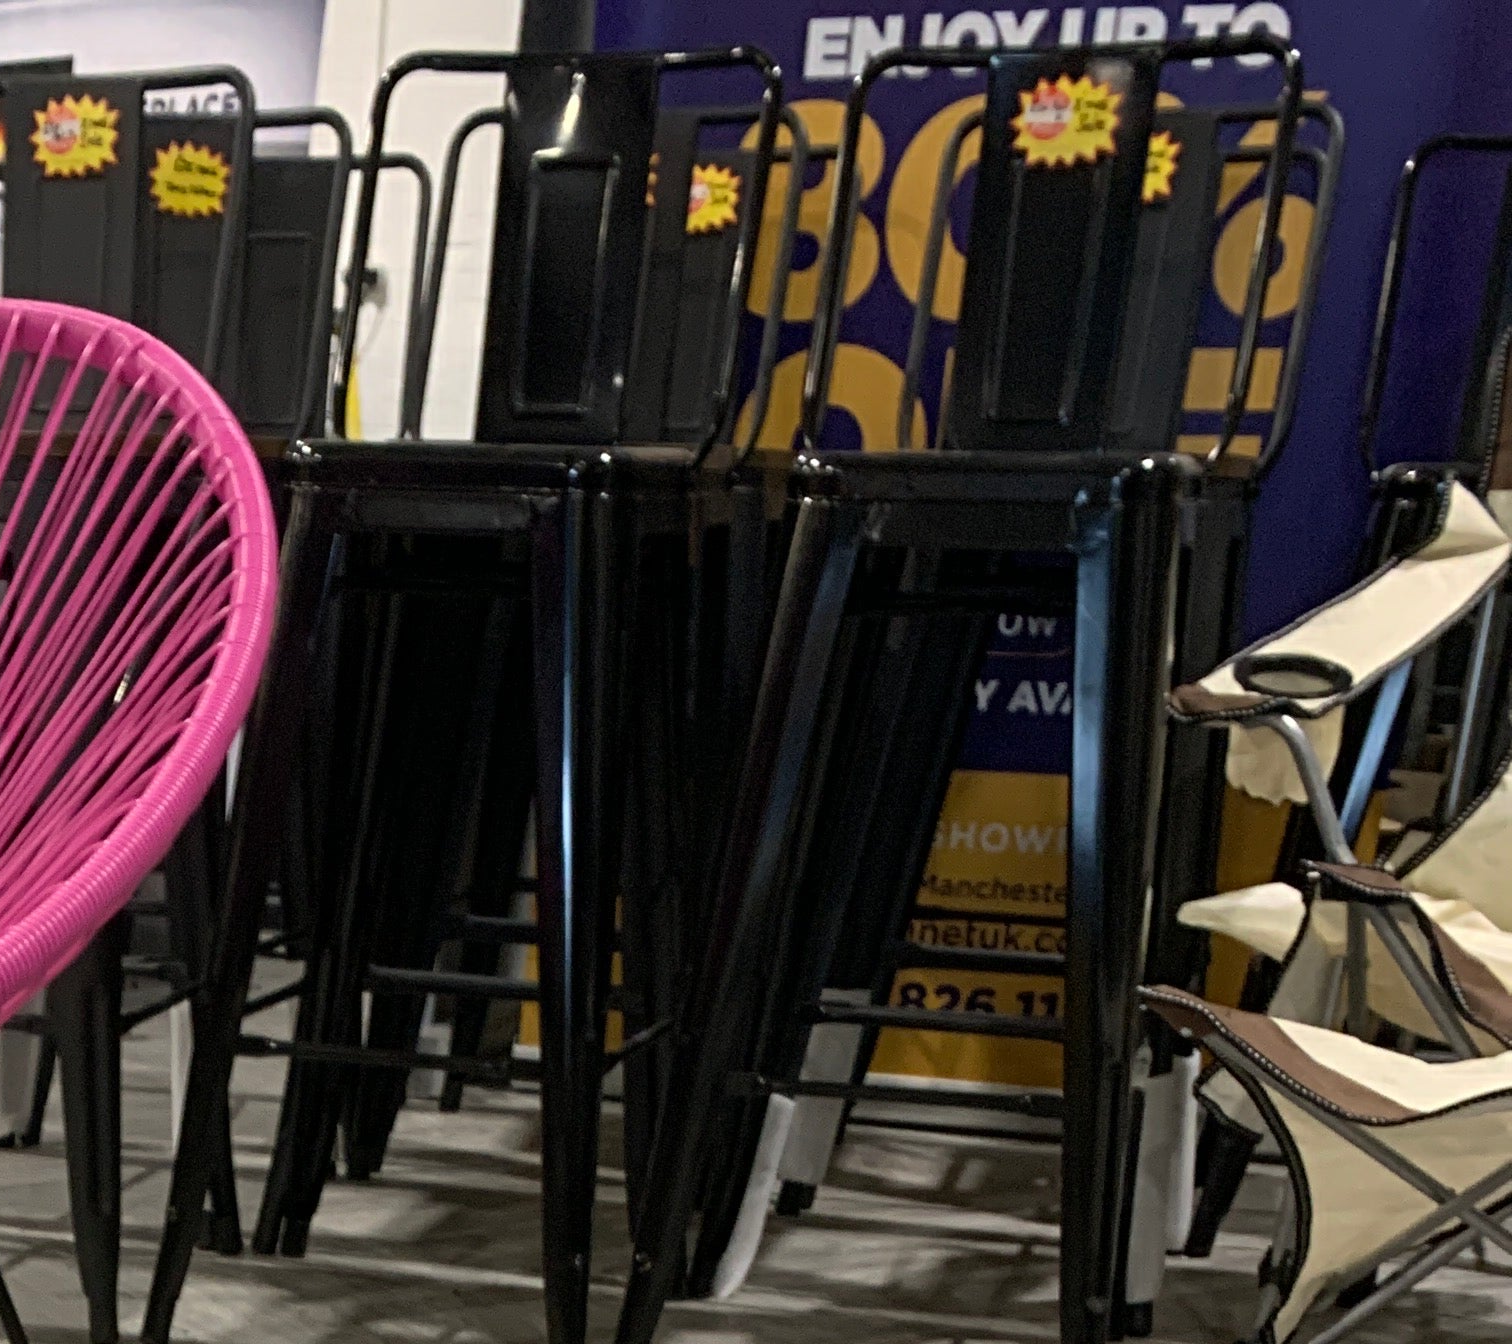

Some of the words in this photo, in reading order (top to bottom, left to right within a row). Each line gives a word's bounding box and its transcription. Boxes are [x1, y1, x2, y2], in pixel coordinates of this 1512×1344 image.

[803, 9, 1050, 80] ENJOY
[1182, 3, 1291, 68] TO
[143, 92, 240, 114] PLACE
